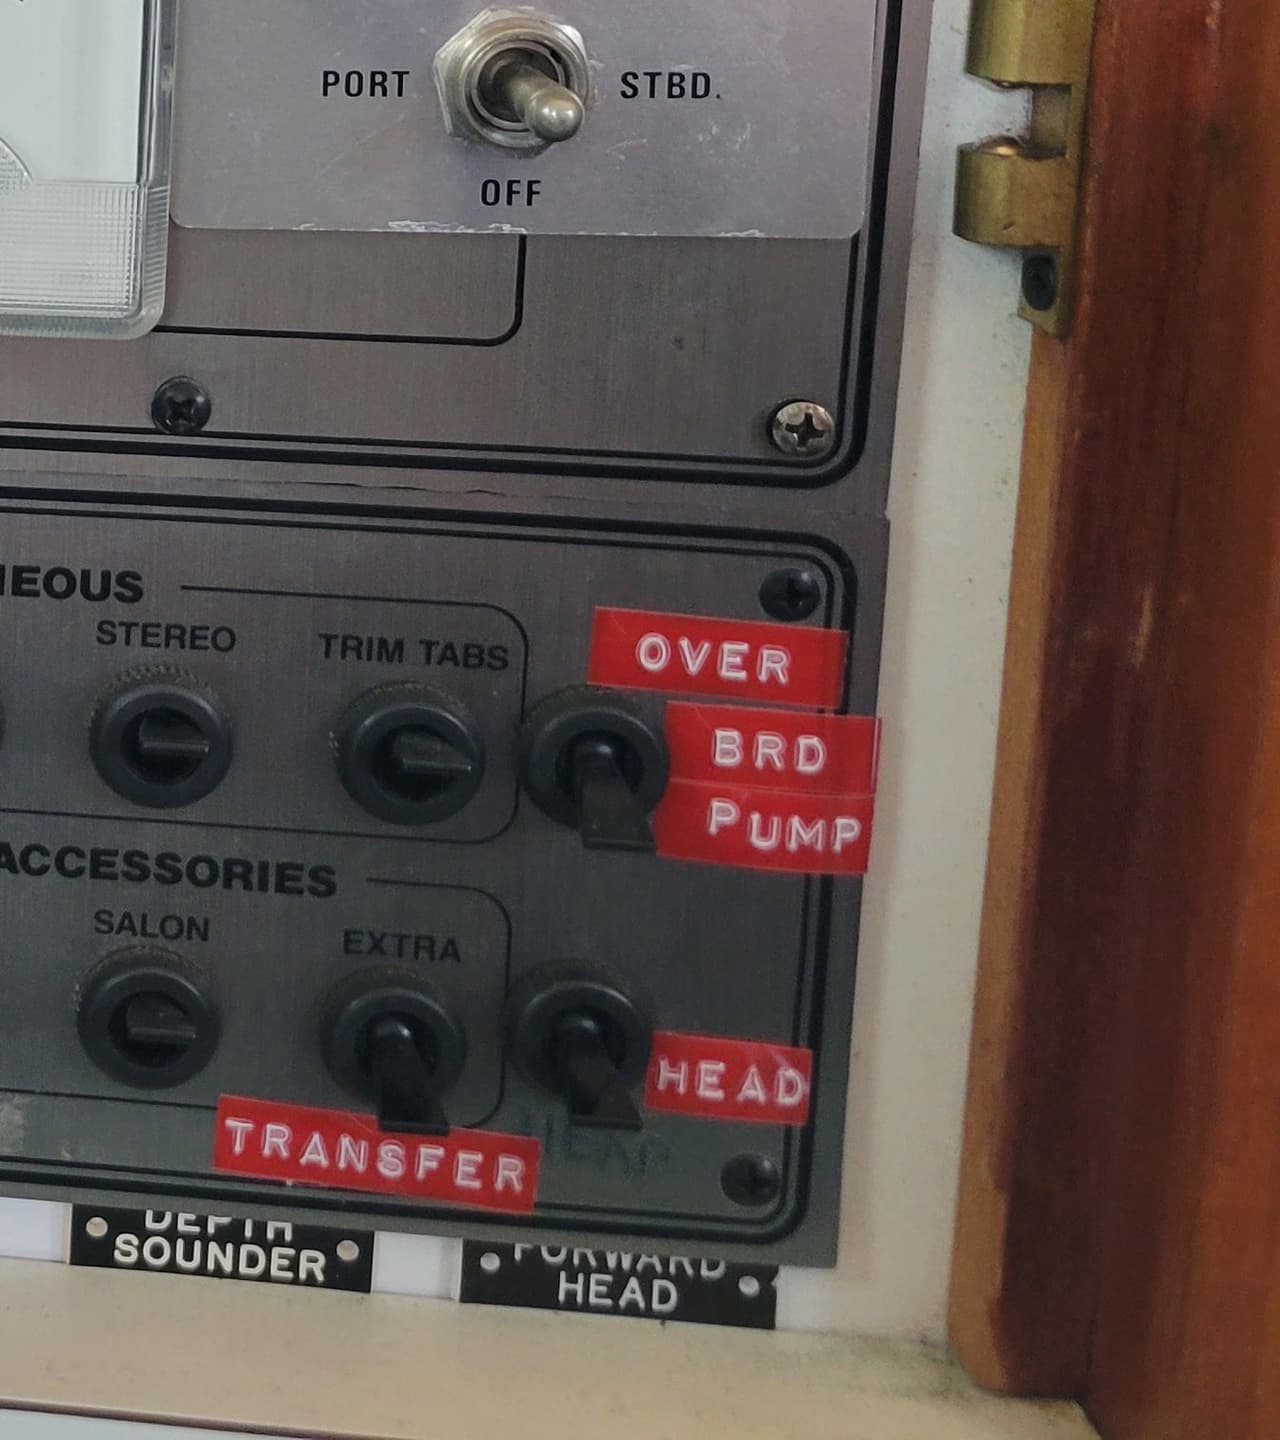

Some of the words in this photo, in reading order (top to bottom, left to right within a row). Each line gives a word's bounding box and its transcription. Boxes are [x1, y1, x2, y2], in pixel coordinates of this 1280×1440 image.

[322, 70, 411, 98] PORT
[620, 71, 722, 100] STBD.
[480, 178, 542, 207] OFF
[95, 620, 237, 653] STEREO
[319, 632, 405, 664] TRIM
[418, 639, 509, 671] TABS
[635, 631, 792, 685] OVER
[712, 728, 827, 775] BRD
[707, 799, 863, 854] PUMP
[93, 909, 211, 944] SALON
[343, 930, 463, 964] EXTRA
[655, 1056, 807, 1108] HEAD
[224, 1117, 526, 1193] TRANSFER
[113, 1233, 326, 1283] SOUNDER
[557, 1270, 679, 1313] HEAD
